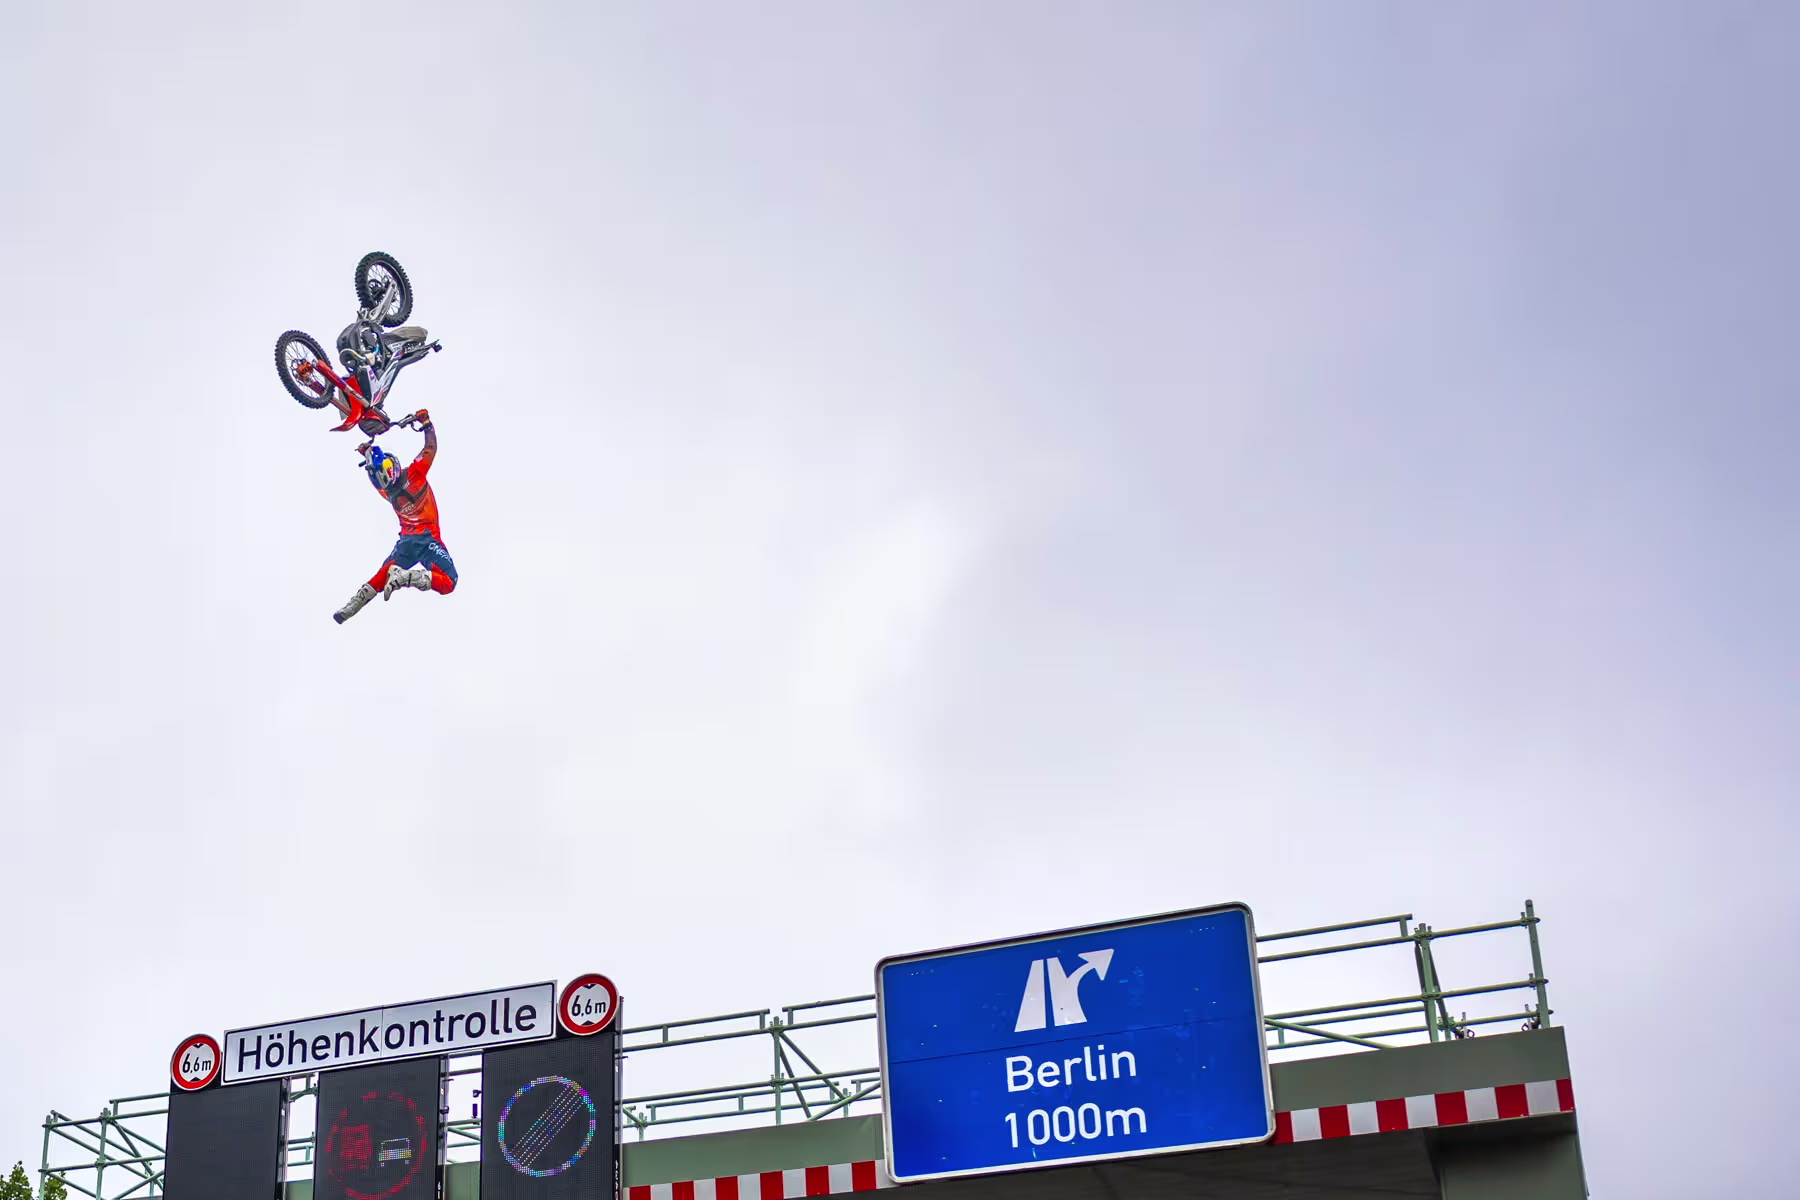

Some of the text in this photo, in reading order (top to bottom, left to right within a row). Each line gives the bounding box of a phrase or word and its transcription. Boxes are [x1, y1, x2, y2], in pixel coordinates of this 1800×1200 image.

[237, 998, 537, 1072] Höhenkontrolle
[1005, 1044, 1137, 1093] Berlin
[1005, 1102, 1147, 1148] 1000m
